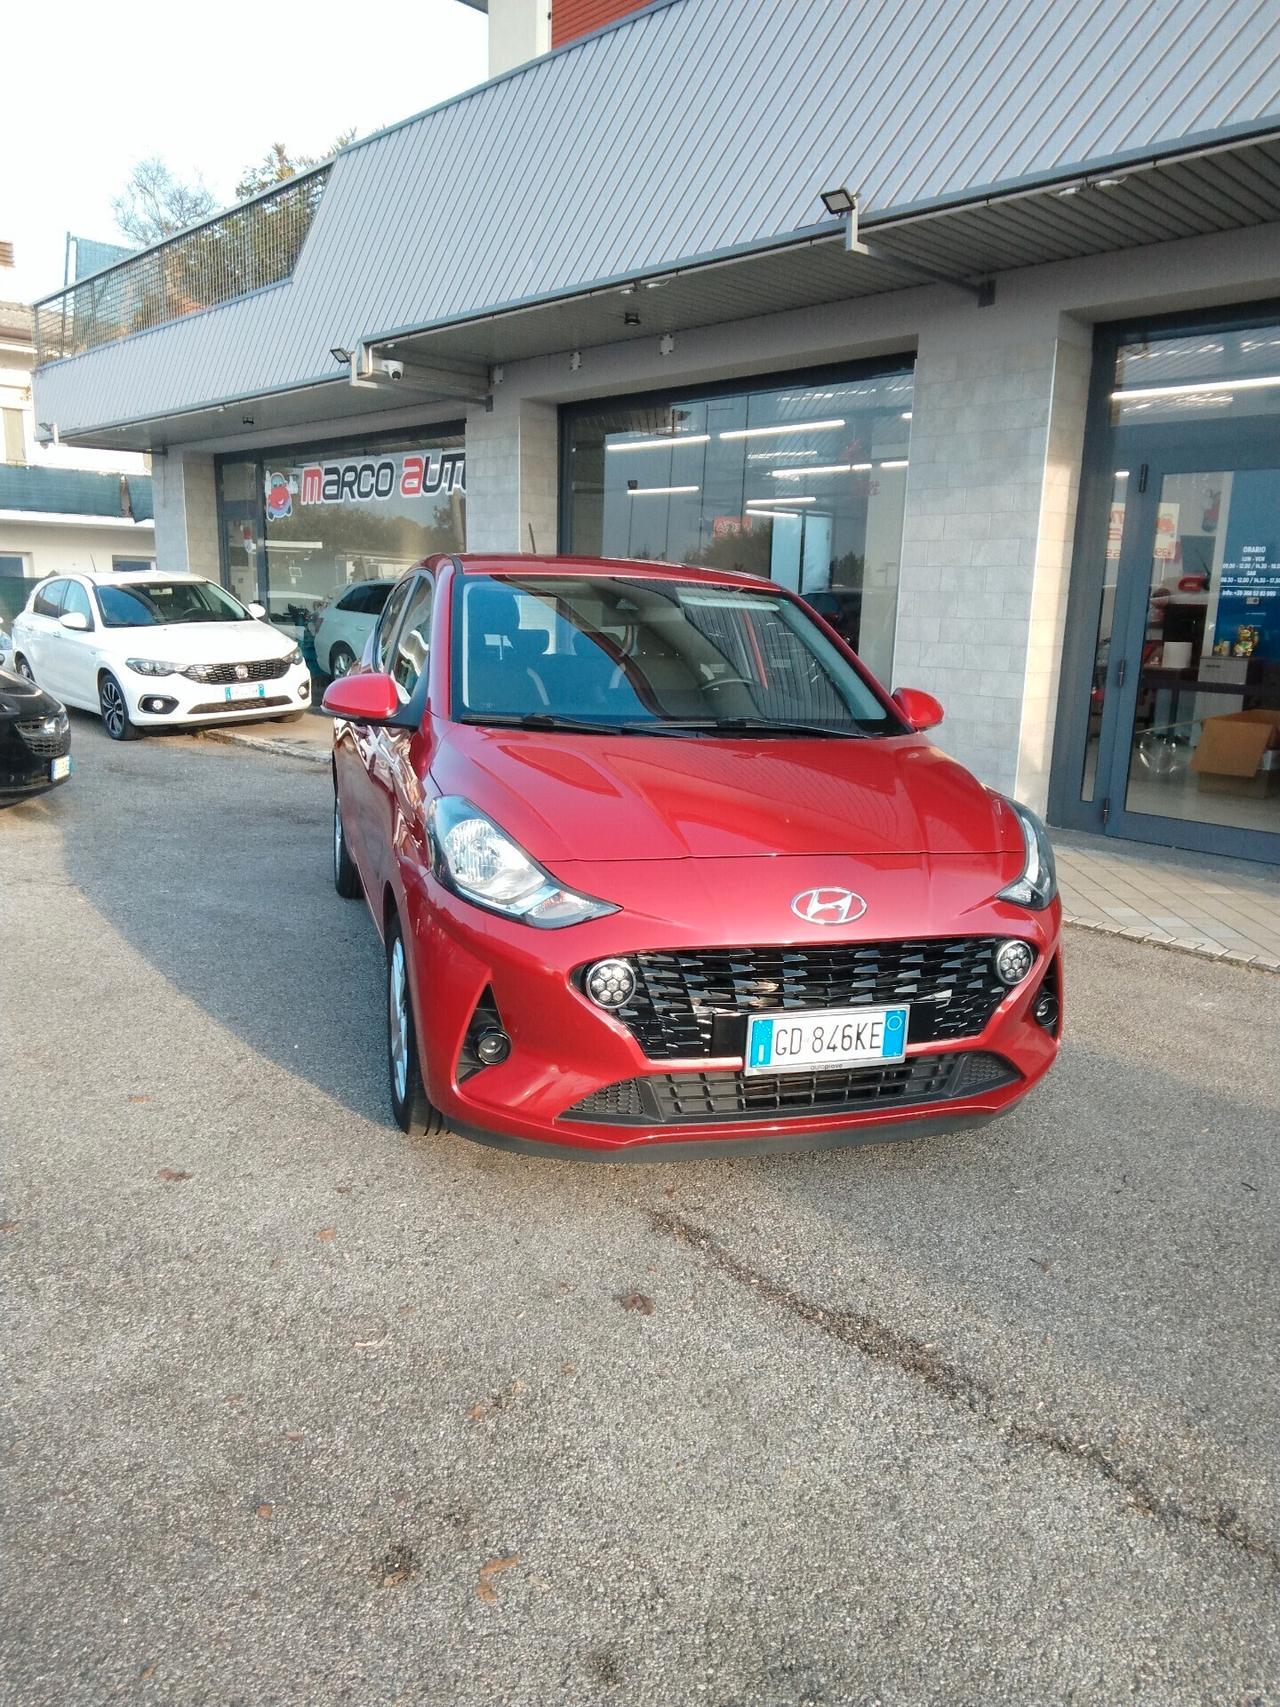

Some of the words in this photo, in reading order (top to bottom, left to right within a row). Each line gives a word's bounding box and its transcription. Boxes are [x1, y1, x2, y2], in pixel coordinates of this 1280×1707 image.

[402, 452, 466, 495] AUT
[775, 1027, 803, 1056] GD
[812, 1022, 884, 1054] 846KE
